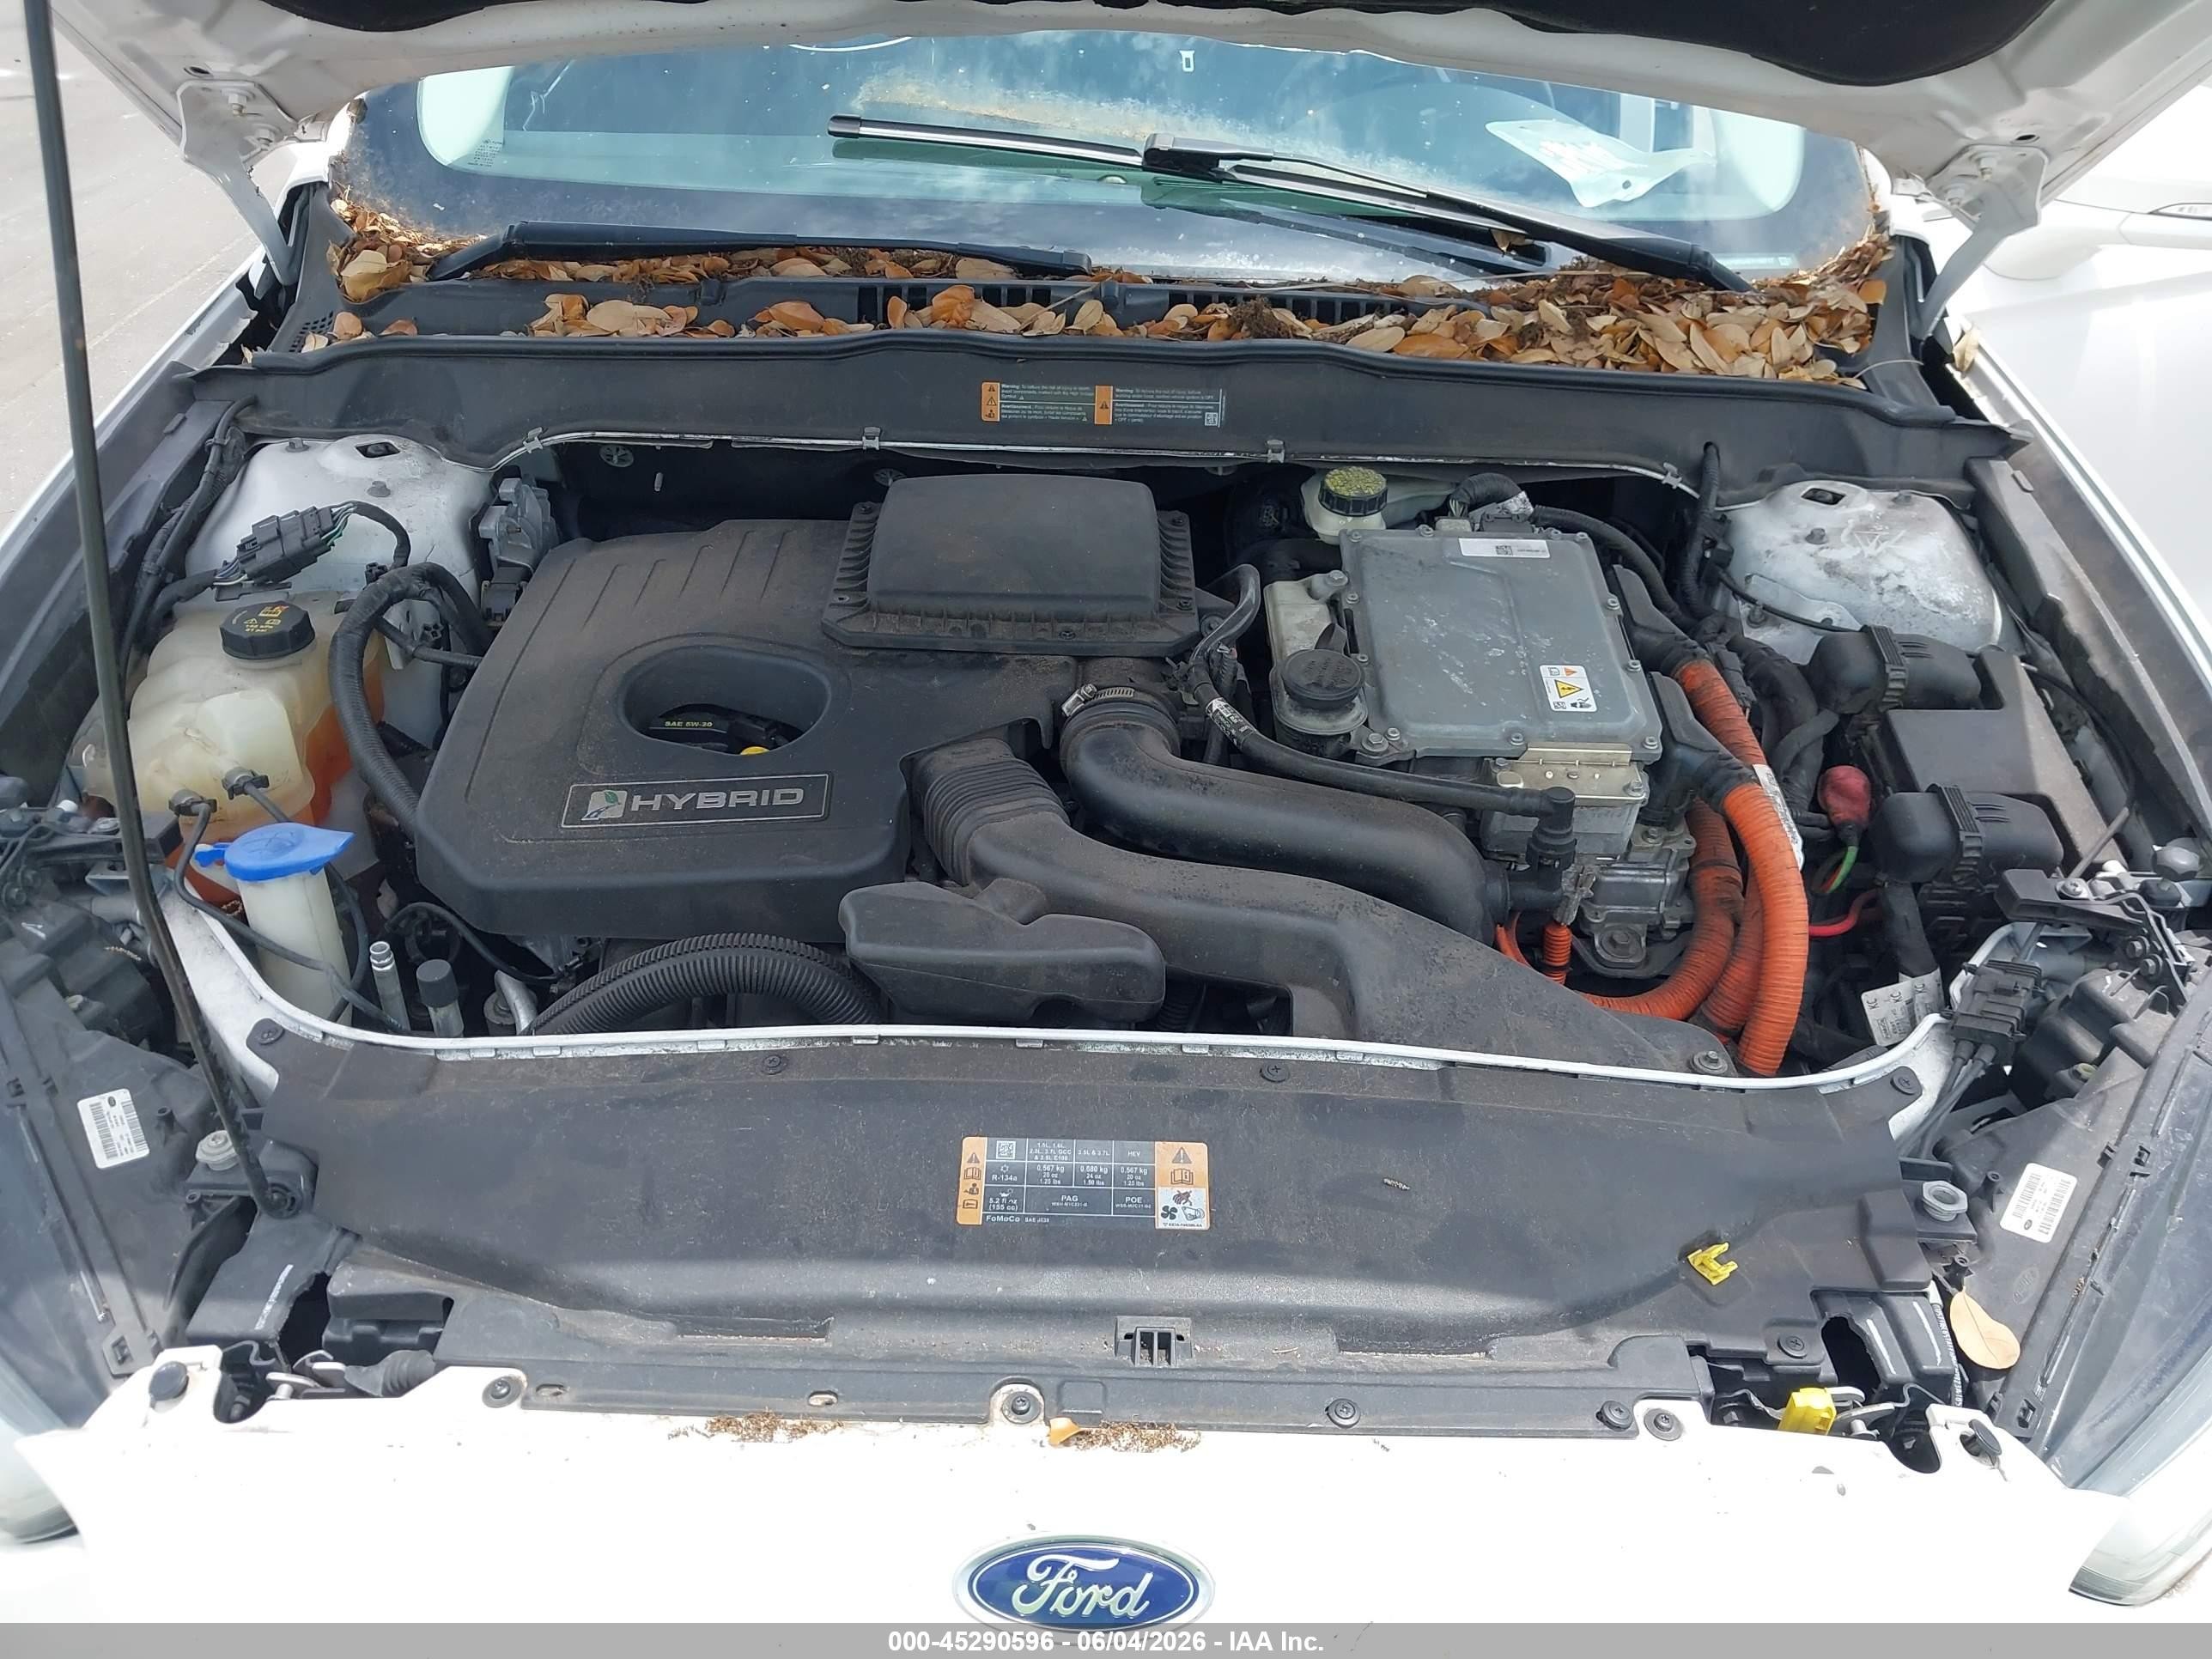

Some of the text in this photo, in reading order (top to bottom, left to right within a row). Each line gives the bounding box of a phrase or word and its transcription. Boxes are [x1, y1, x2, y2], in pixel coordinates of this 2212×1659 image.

[630, 788, 805, 811] HYBRID
[1890, 992, 1902, 1003] KC
[1867, 998, 1879, 1010] KC
[1055, 1164, 1065, 1173] kg
[1010, 1553, 1155, 1618] Ford
